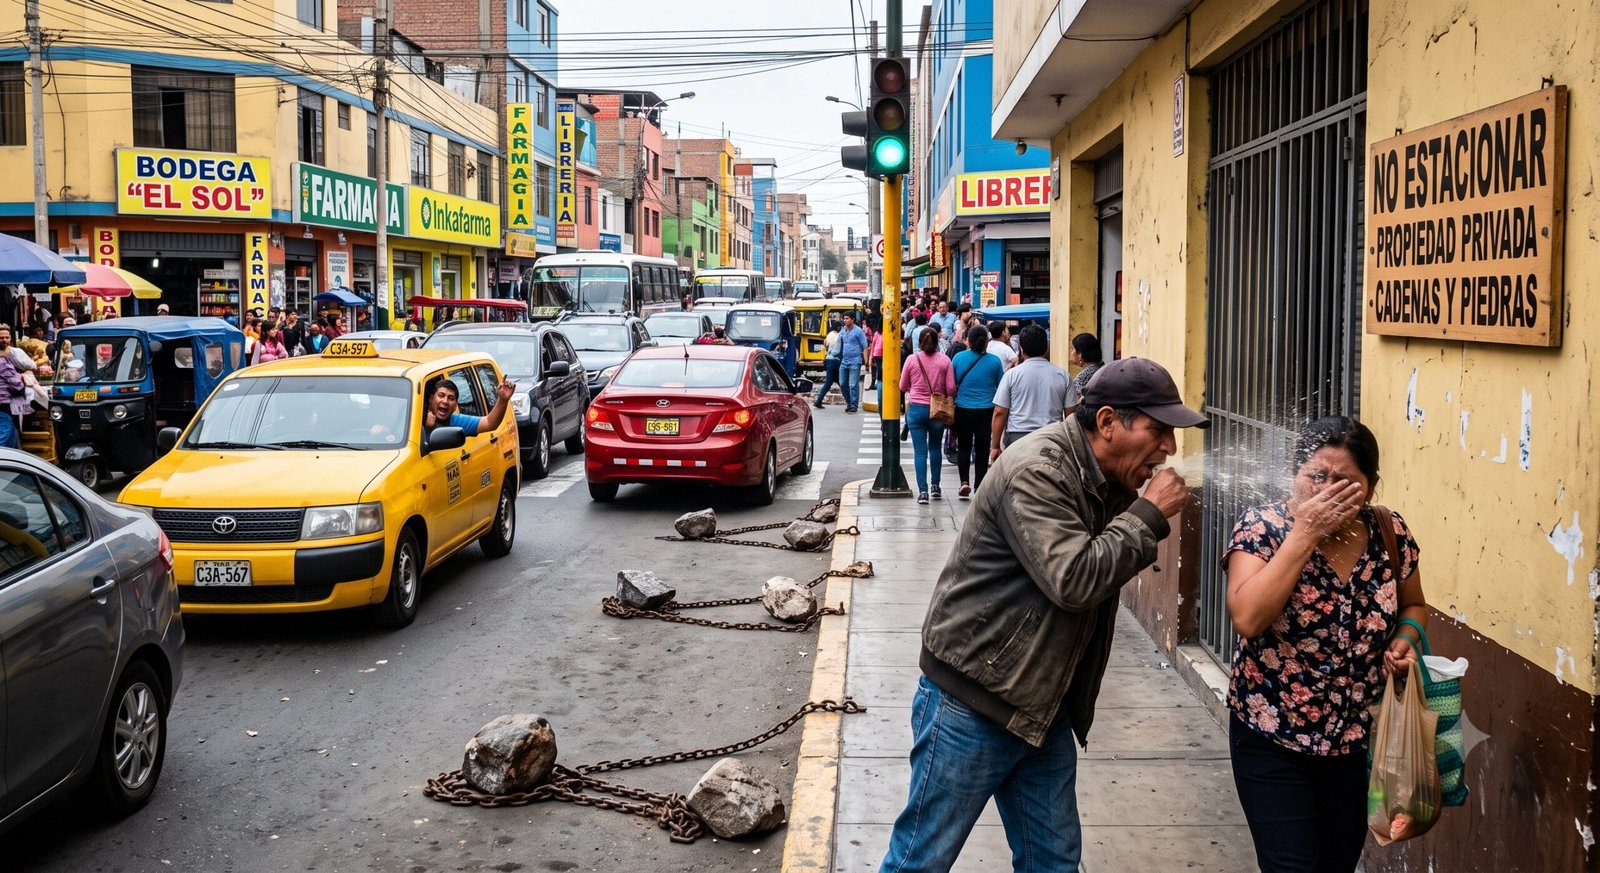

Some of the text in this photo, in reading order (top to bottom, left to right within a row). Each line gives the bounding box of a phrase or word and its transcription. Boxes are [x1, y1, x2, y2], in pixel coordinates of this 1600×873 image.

[137, 155, 257, 183] BODEGA
[559, 115, 573, 222] LIBRERIA
[1373, 107, 1547, 215] NO ESTACIONAR
[311, 173, 401, 228] FARMAIA
[433, 200, 491, 237] Inkafarma
[1376, 204, 1538, 268] PROPIEDAD PRIVADA
[1375, 273, 1538, 329] CADENAS Y PIEDRAS
[196, 567, 248, 583] C3A-567
